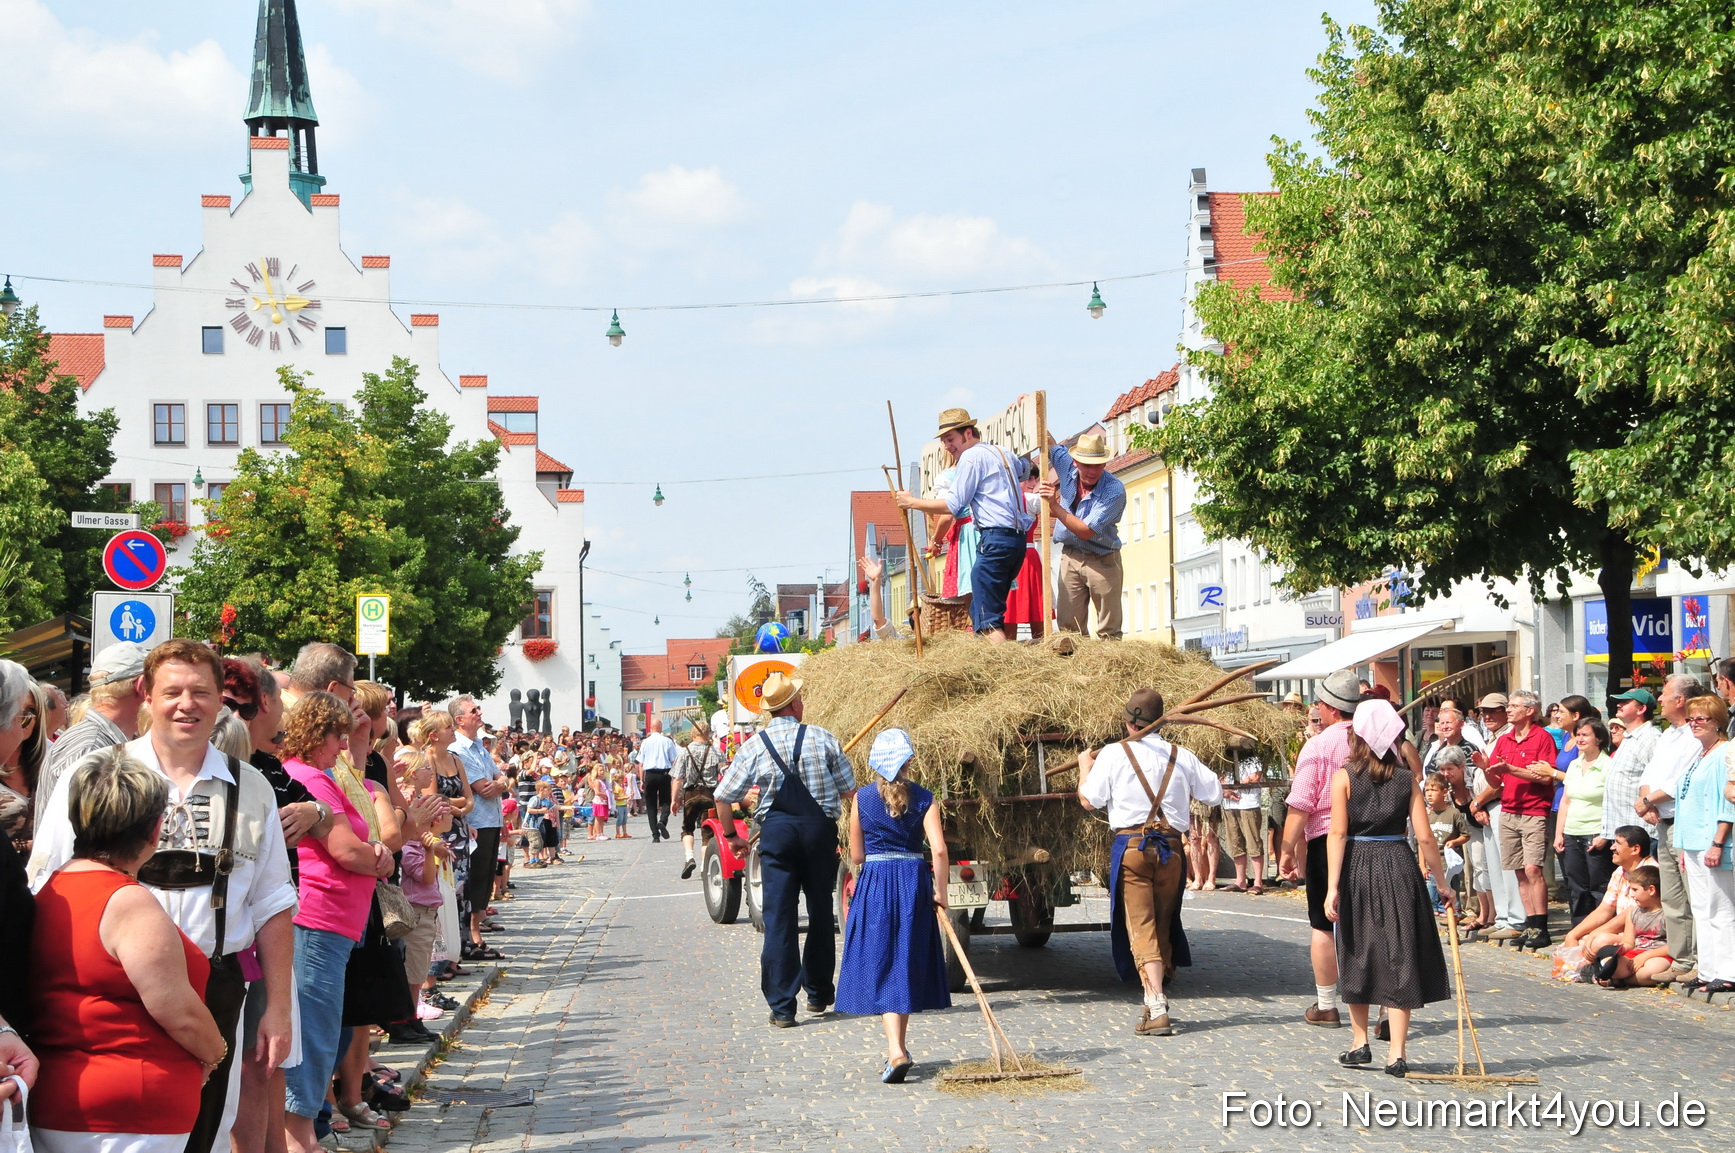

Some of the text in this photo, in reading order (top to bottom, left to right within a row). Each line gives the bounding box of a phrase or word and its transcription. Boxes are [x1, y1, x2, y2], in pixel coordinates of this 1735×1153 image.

[77, 514, 130, 526] Ulmer Gasse
[1589, 619, 1607, 636] Bücher
[1631, 613, 1673, 636] Vid
[958, 884, 976, 895] NM
[953, 893, 981, 904] TR 53
